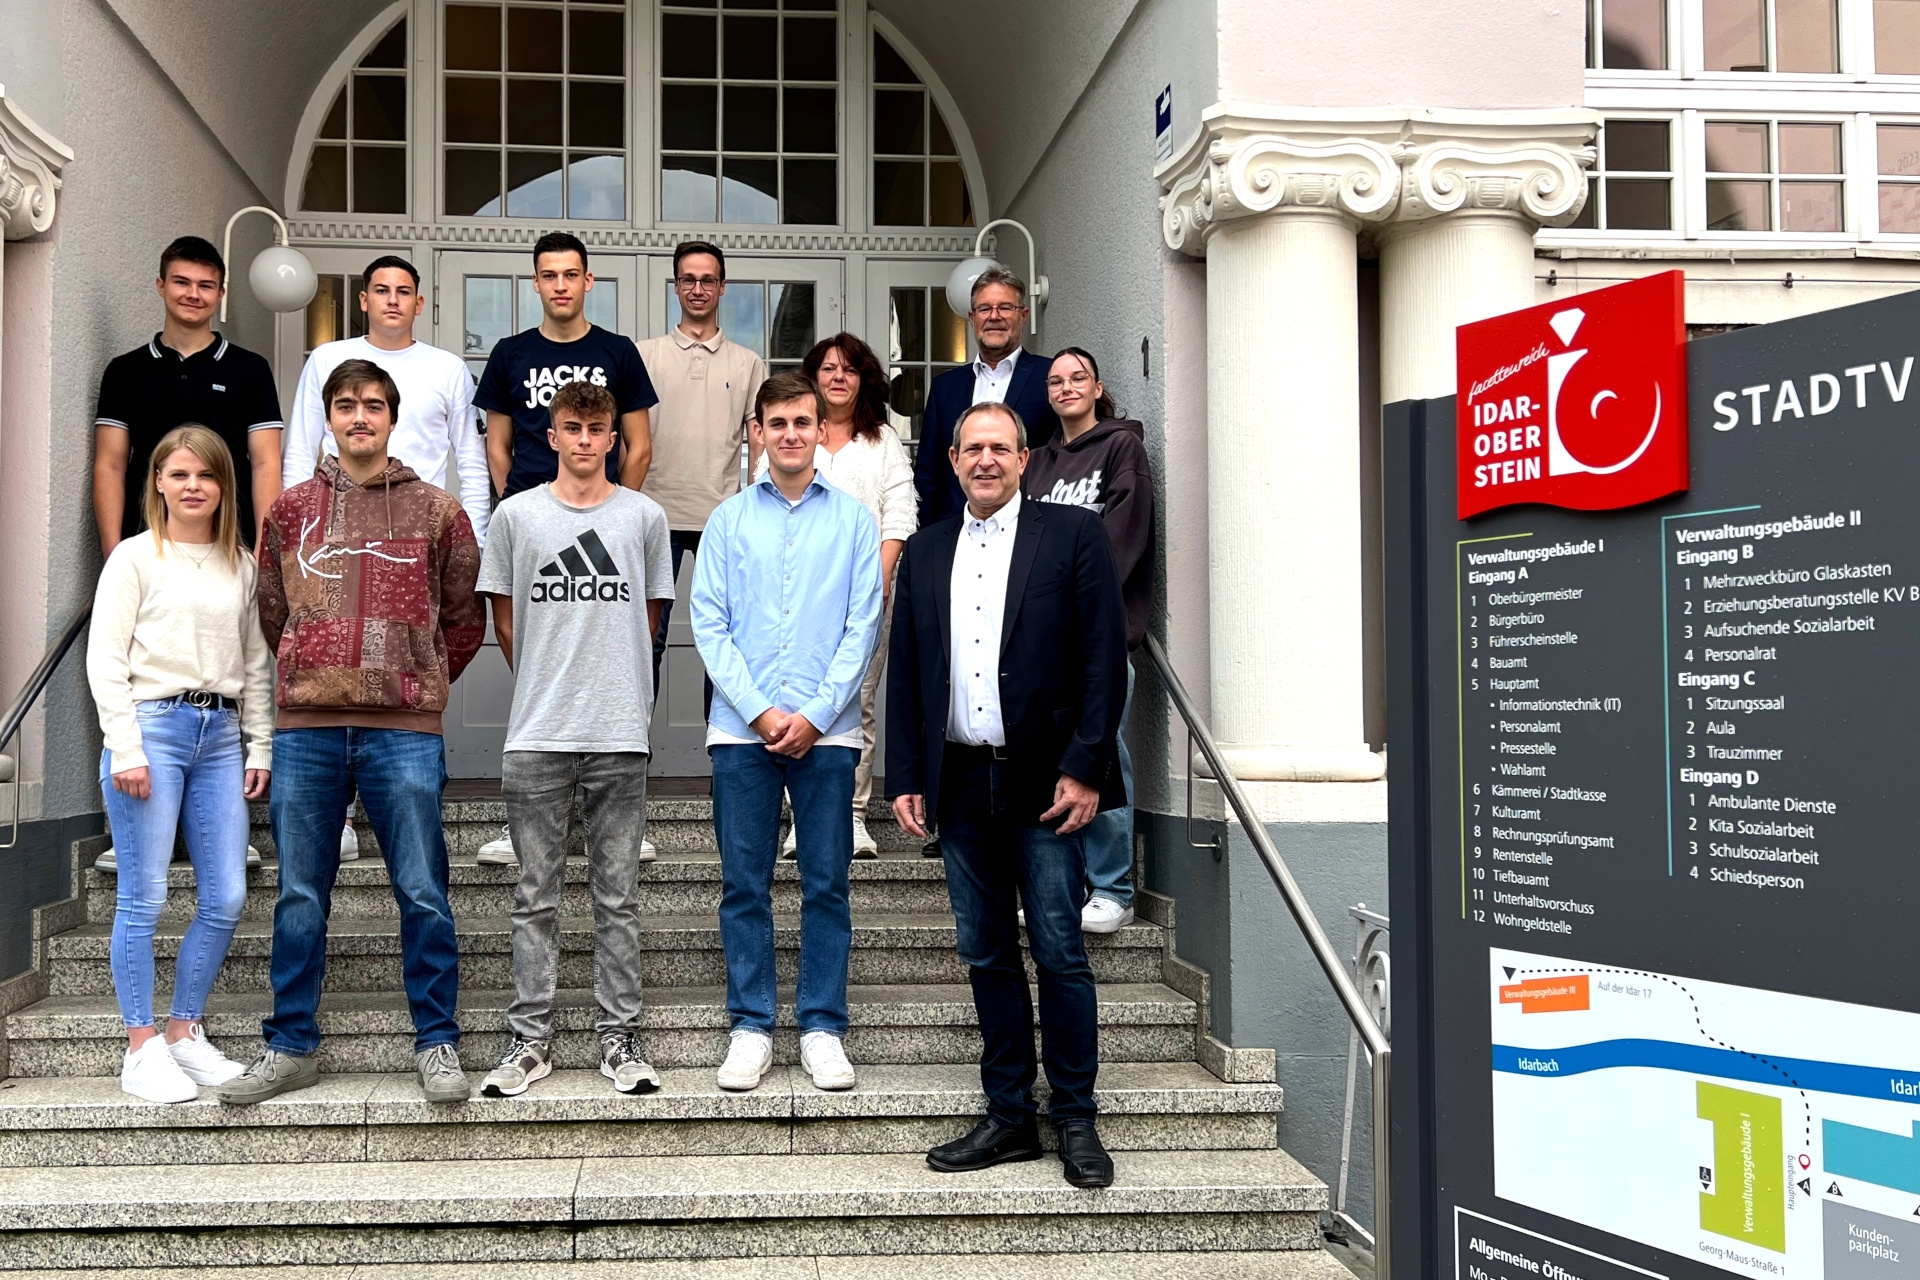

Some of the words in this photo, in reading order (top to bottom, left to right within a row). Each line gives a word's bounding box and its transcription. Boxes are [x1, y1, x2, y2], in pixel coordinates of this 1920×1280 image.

[1713, 356, 1915, 431] STADTV
[1474, 396, 1541, 427] IDAR-
[1474, 425, 1541, 457] OBER
[1474, 456, 1541, 488] STEIN
[1676, 513, 1845, 543] Verwaltungsgebäude
[1850, 510, 1861, 525] II
[1468, 542, 1596, 565] Verwaltungsgebäude
[1599, 539, 1603, 551] I
[1677, 549, 1738, 566] Eingang
[1742, 545, 1754, 558] B
[1469, 571, 1515, 585] Eingang
[1518, 567, 1528, 579] A
[1685, 578, 1690, 590] 1
[1704, 569, 1810, 588] Mehrzweckbüro
[1814, 564, 1891, 580] Glaskasten
[531, 576, 630, 602] adidas
[1472, 596, 1475, 606] 1
[1489, 588, 1583, 605] Oberbürgermeister
[1684, 602, 1692, 614] 2
[1704, 589, 1879, 613] Erziehungsberatungsstelle
[1884, 587, 1905, 602] KV
[1471, 616, 1477, 627] 2
[1490, 613, 1544, 628] Bürgerbüro
[1685, 626, 1692, 638] 3
[1704, 620, 1790, 637] Aufsuchende
[1794, 616, 1875, 633] Sozialarbeit
[1471, 637, 1477, 648] 3
[1490, 632, 1577, 647] Führerscheinstelle
[1472, 658, 1478, 668] 4
[1490, 657, 1527, 668] Bauamt
[1685, 650, 1693, 661] 4
[1705, 647, 1776, 661] Personalrat
[1472, 679, 1478, 690] 5
[1490, 678, 1539, 692] Hauptamt
[1678, 672, 1739, 690] Eingang
[1744, 671, 1755, 685] C
[1500, 698, 1601, 711] Informationstechnik
[1604, 698, 1621, 712] (IT)
[1687, 698, 1692, 709] 1
[1706, 696, 1784, 713] Sitzungssaal
[1500, 721, 1561, 733] Personalamt
[1686, 721, 1694, 734] 2
[1706, 721, 1735, 734] Aula
[1501, 742, 1556, 755] Pressestelle
[1687, 745, 1695, 758] 3
[1706, 746, 1783, 760] Trauzimmer
[1500, 764, 1546, 776] Wahlamt
[1681, 768, 1742, 788] Eingang
[1747, 771, 1759, 784] D
[1474, 784, 1480, 795] 6
[1492, 785, 1541, 798] Kämmerei
[1551, 787, 1606, 801] Stadtkasse
[1474, 805, 1480, 815] 7
[1493, 806, 1540, 820] Kulturamt
[1690, 794, 1694, 806] 1
[1708, 795, 1780, 811] Ambulante
[1784, 798, 1836, 814] Dienste
[1689, 817, 1696, 830] 2
[1709, 819, 1733, 833] Kita
[1738, 820, 1814, 838] Sozialarbeit
[1474, 826, 1481, 837] 8
[1493, 827, 1614, 849] Rechnungsprüfungsamt
[1474, 847, 1481, 858] 9
[1493, 848, 1553, 865] Rentenstelle
[1689, 842, 1697, 854] 3
[1710, 843, 1819, 865] Schulsozialarbeit
[1473, 868, 1484, 879] 10
[1493, 870, 1549, 887] Tiefbauamt
[1690, 866, 1698, 878] 4
[1710, 868, 1804, 889] Schiedsperson
[1473, 889, 1483, 900] 11
[1494, 891, 1594, 915] Unterhaltsvorschuss
[1474, 910, 1485, 922] 12
[1494, 913, 1571, 934] Wohngeldstelle
[1504, 987, 1568, 999] Verwaltungsgebäude
[1598, 982, 1610, 990] Auf
[1612, 984, 1623, 993] der
[1626, 986, 1640, 996] Idar
[1643, 989, 1652, 998] 17
[1518, 1058, 1559, 1071] Idarbach
[1891, 1079, 1920, 1096] Idar
[1740, 1121, 1755, 1232] Verwaltungsgebäude
[1788, 1155, 1796, 1210] Haupteingang
[1803, 1180, 1809, 1189] A
[1832, 1185, 1837, 1195] B
[1849, 1223, 1894, 1245] Kunden-
[1469, 1237, 1539, 1273] Allgemeine
[1699, 1242, 1777, 1274] Georg-Maus-Straße
[1781, 1267, 1785, 1276] 1
[1850, 1240, 1899, 1262] parkplatz
